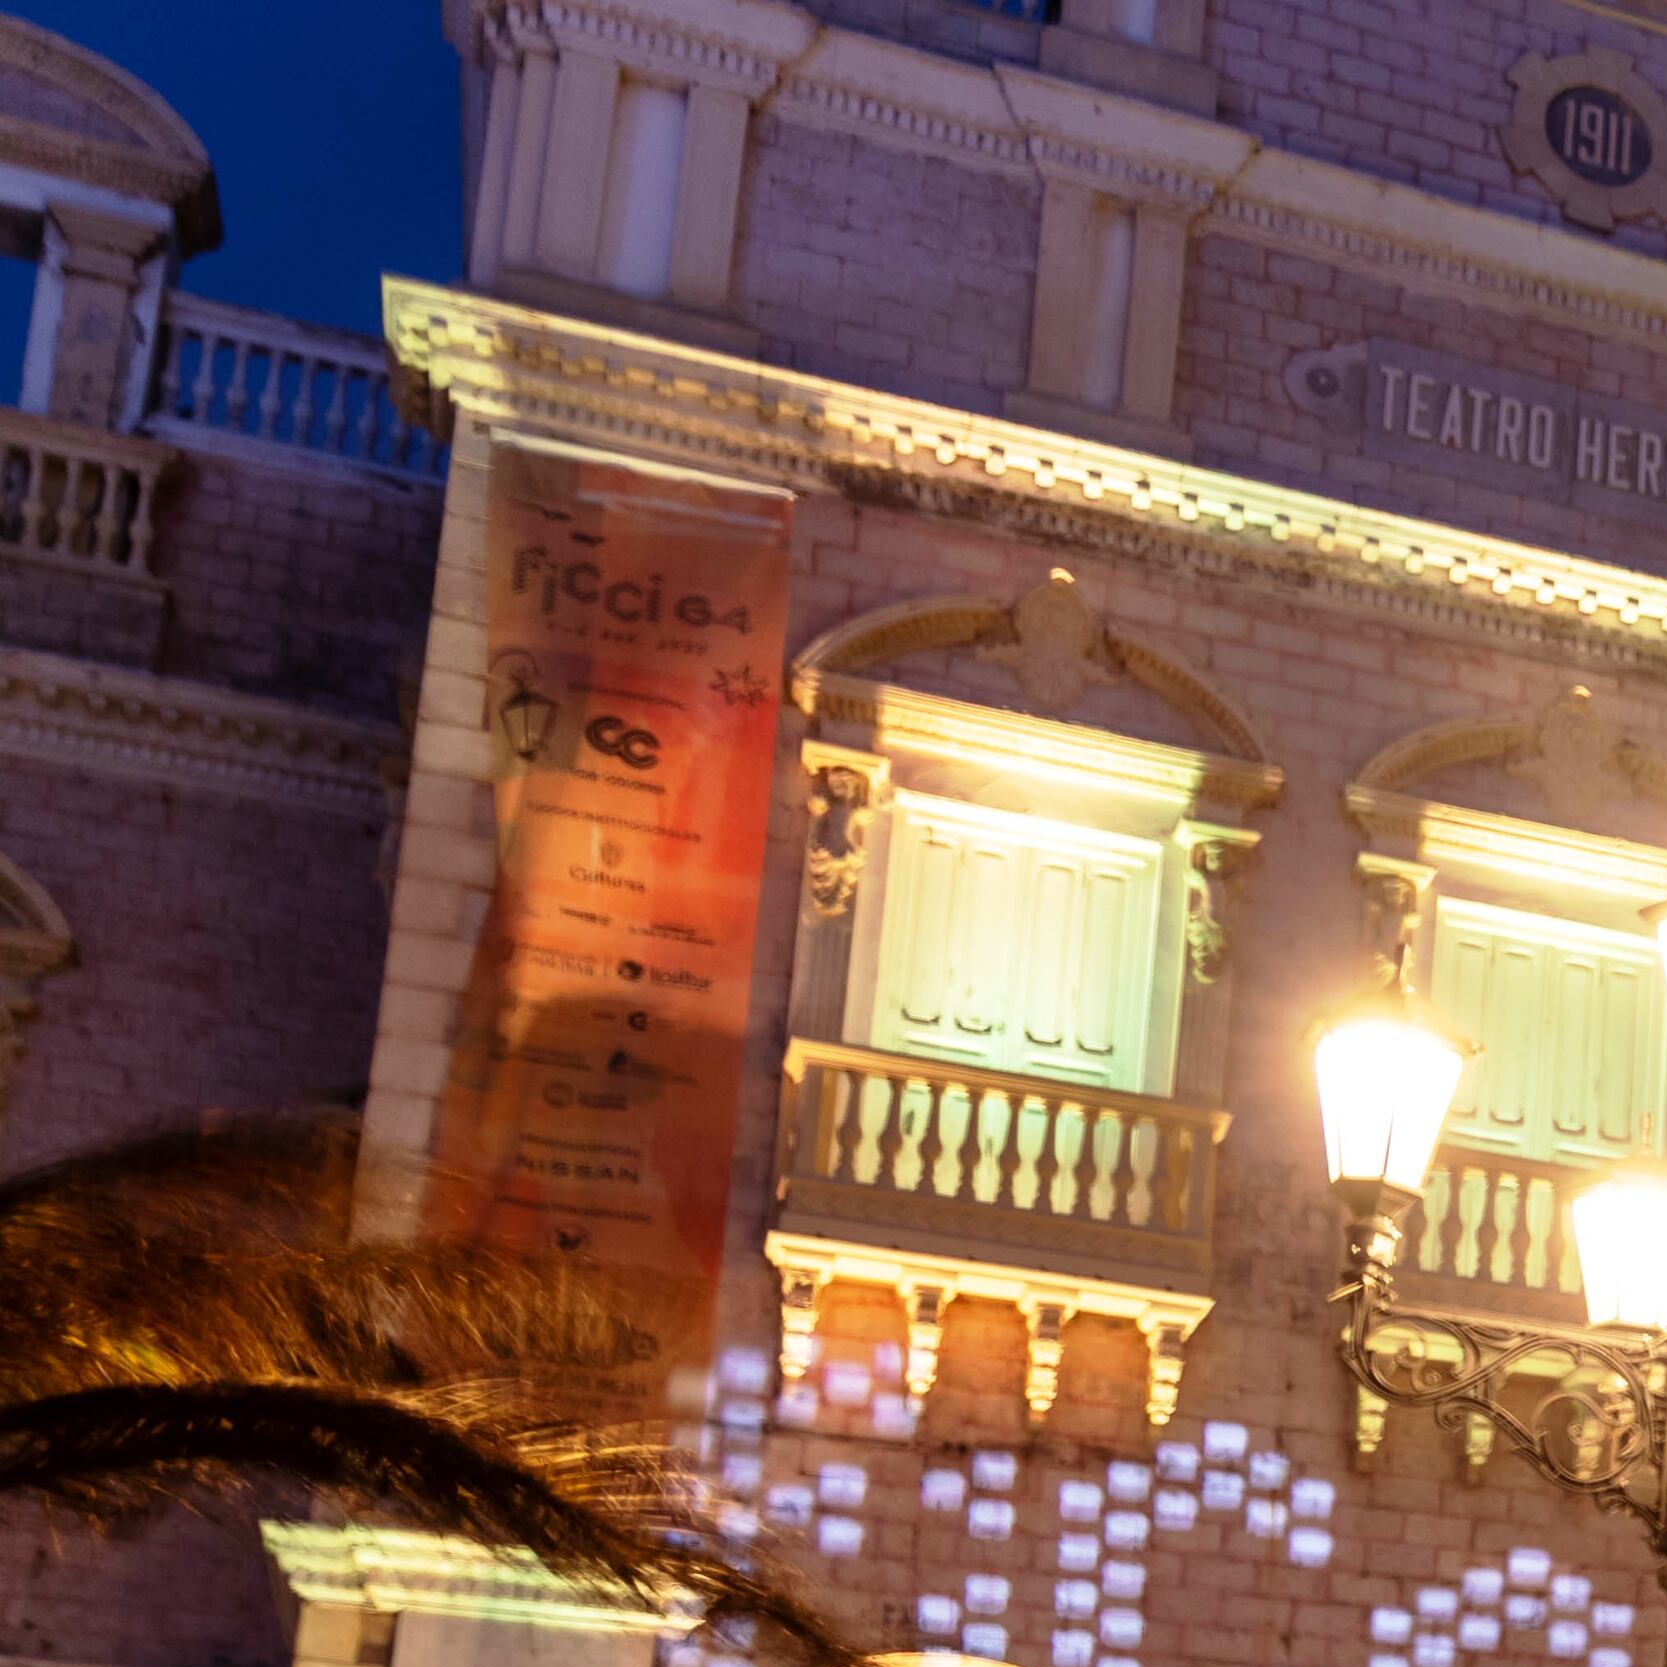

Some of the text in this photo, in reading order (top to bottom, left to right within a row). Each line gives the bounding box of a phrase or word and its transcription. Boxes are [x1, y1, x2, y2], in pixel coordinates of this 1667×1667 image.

[1563, 98, 1632, 176] 1911
[1380, 365, 1555, 470] TEATRO
[515, 1152, 641, 1185] NISSAN
